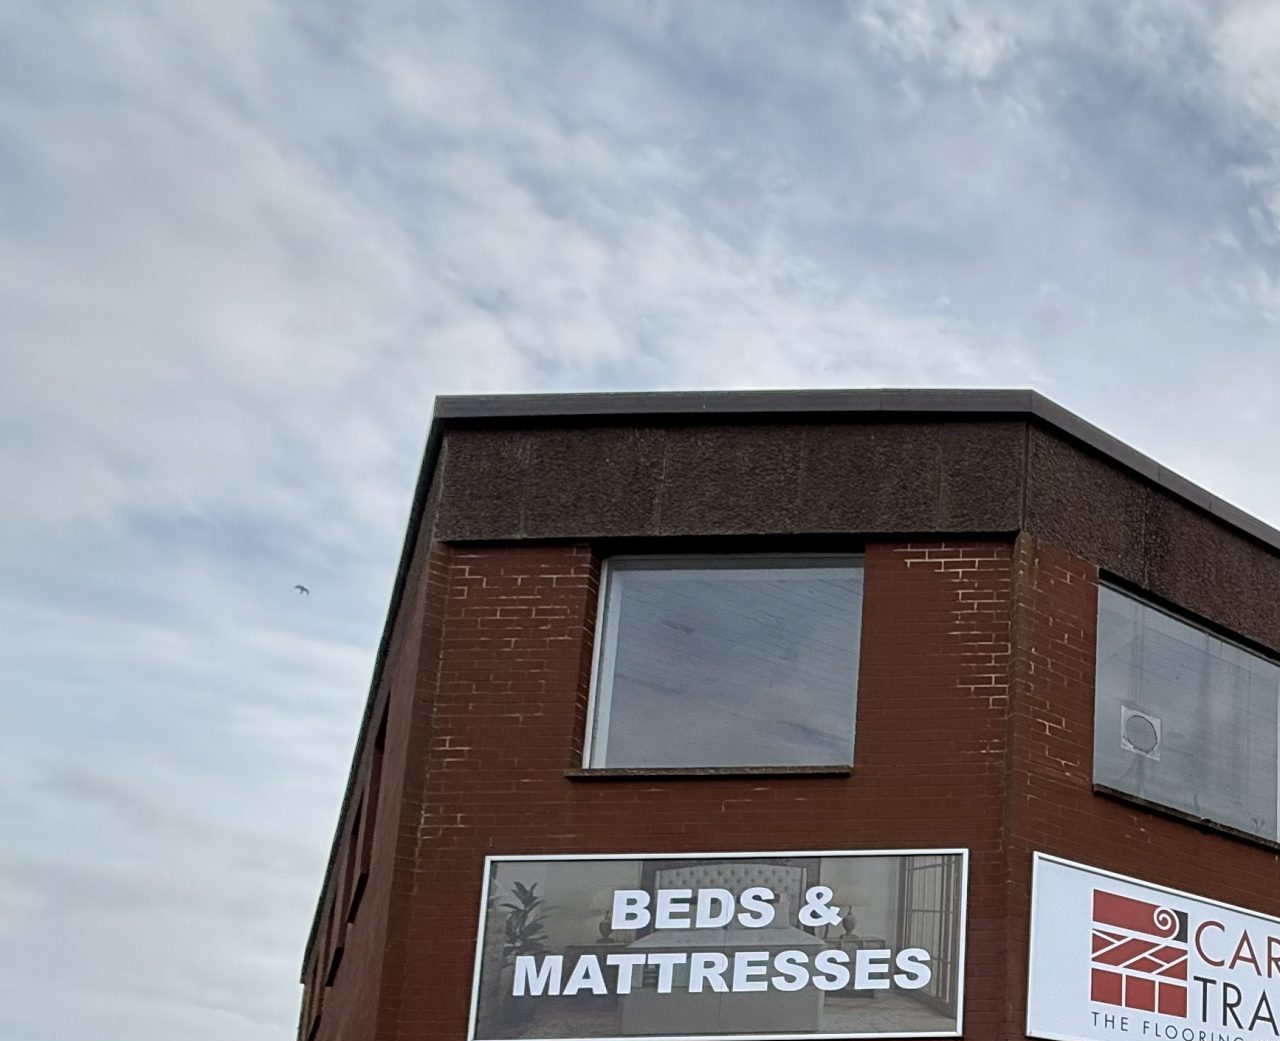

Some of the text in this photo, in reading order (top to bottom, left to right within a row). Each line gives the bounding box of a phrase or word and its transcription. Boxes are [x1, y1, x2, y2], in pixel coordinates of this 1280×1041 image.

[610, 885, 843, 930] BEDS &
[512, 947, 932, 997] MATTRESSES
[1091, 1011, 1129, 1032] THE
